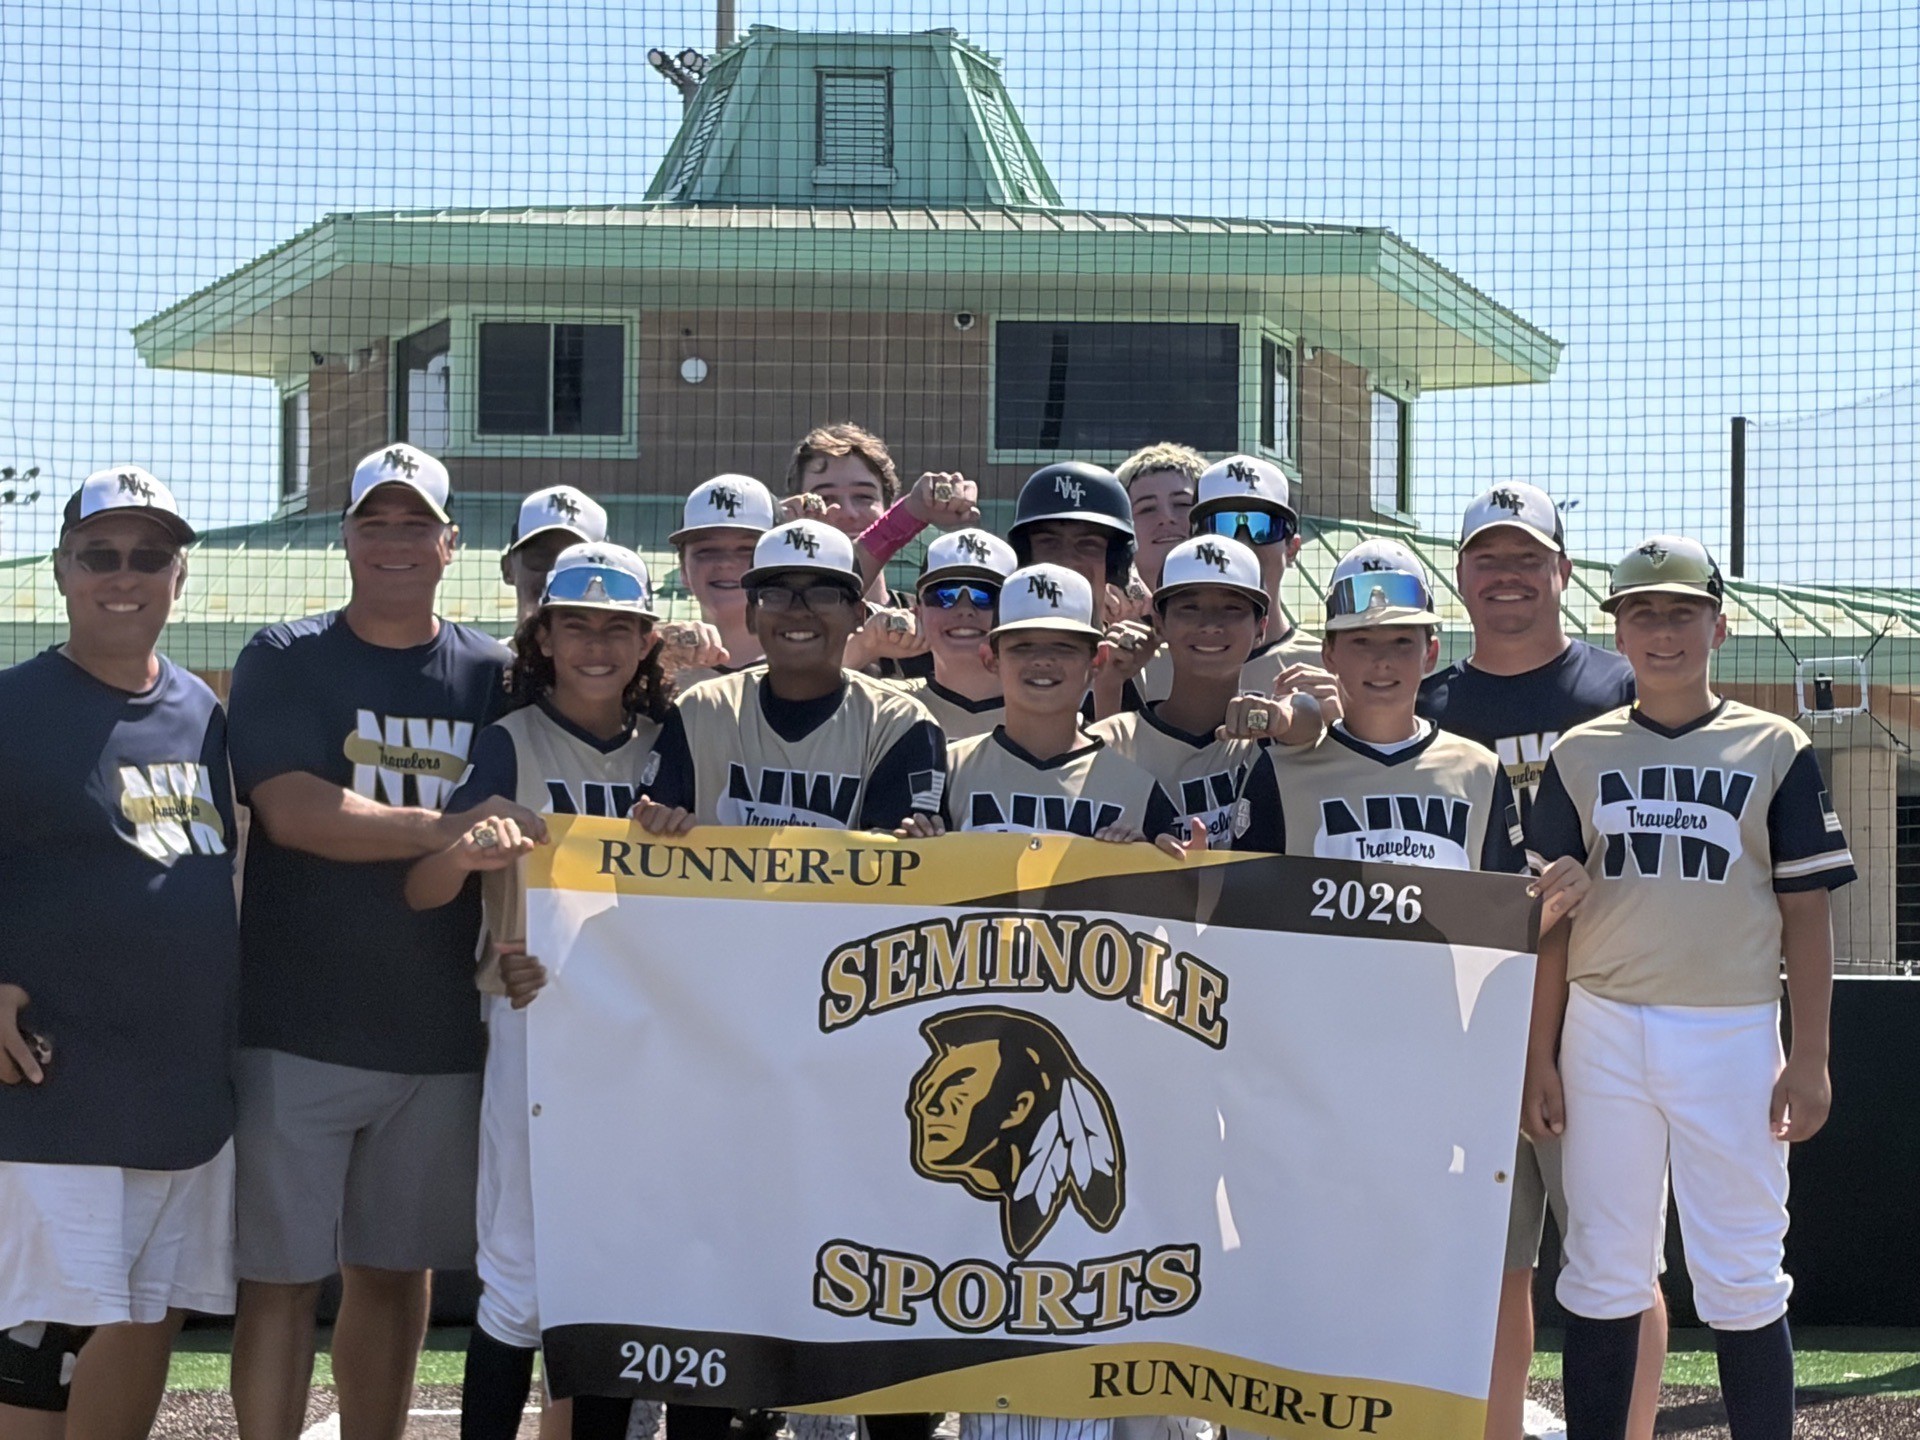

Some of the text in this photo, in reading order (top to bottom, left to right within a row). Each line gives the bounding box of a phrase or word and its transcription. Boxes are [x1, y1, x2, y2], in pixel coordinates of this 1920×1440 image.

[1626, 805, 1707, 830] Travelers
[597, 841, 920, 888] RUNNER-UP
[1356, 837, 1435, 862] Travelers
[1310, 878, 1422, 925] 2026
[819, 911, 1228, 1048] SEMINOLE
[813, 1238, 1201, 1335] SPORTS
[619, 1340, 727, 1388] 2026
[1090, 1360, 1394, 1434] RUNNER-UP
